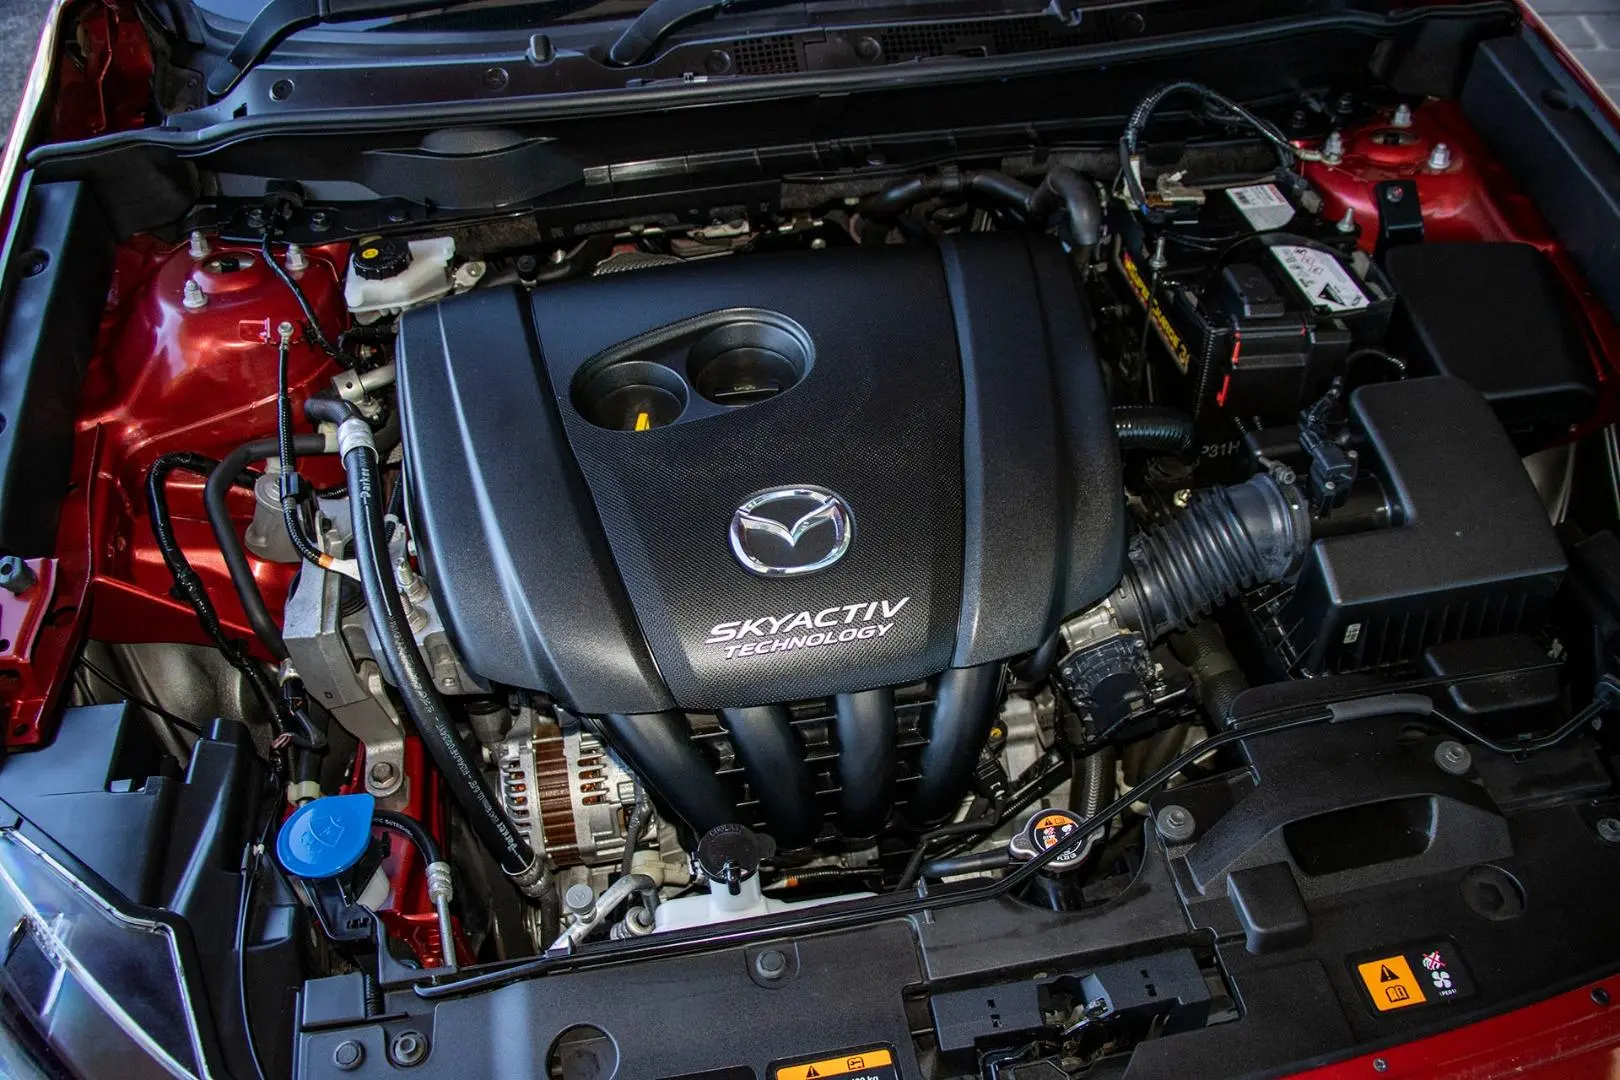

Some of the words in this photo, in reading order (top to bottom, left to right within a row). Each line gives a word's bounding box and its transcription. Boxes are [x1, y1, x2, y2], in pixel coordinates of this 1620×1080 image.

[359, 467, 371, 498] Parker
[705, 597, 910, 644] SKYACTIV
[724, 623, 894, 659] TECHNOLOGY
